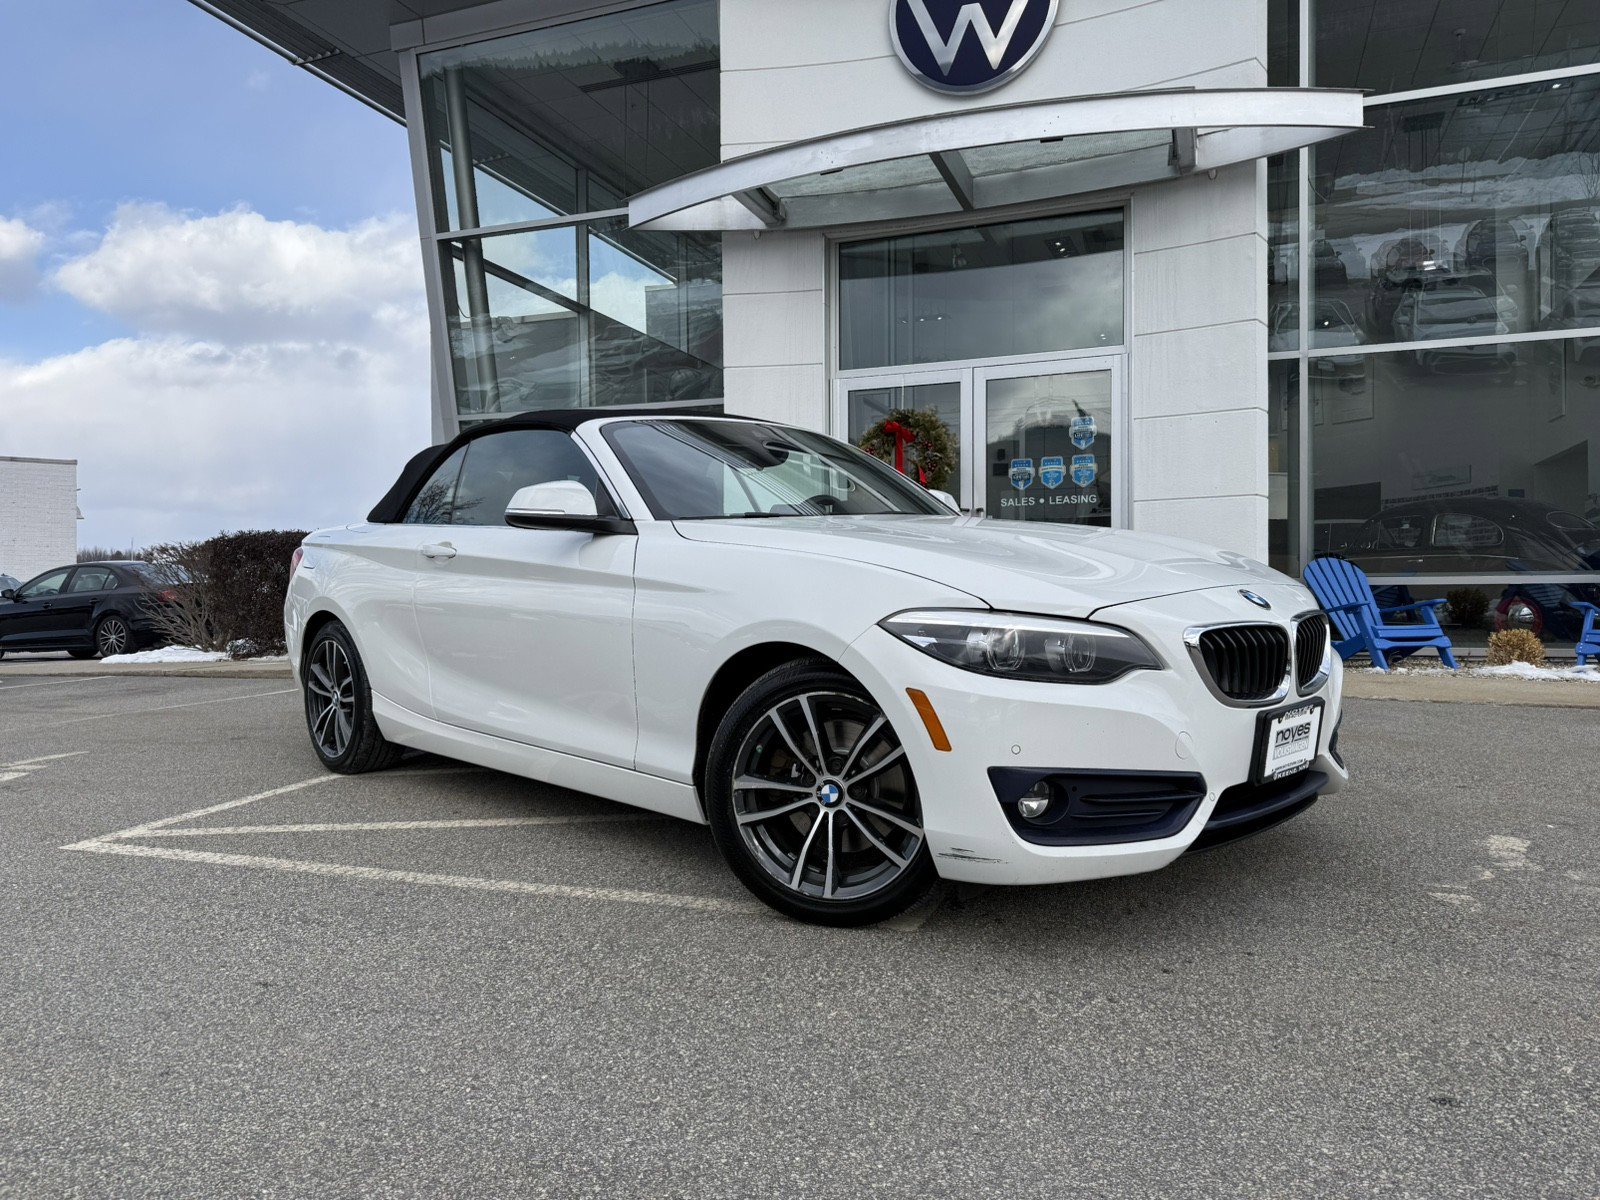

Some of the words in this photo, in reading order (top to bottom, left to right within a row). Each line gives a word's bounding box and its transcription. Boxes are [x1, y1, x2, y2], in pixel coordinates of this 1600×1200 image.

[1000, 497, 1036, 507] SALES
[1049, 494, 1098, 505] LEASING
[1276, 722, 1311, 743] noyes
